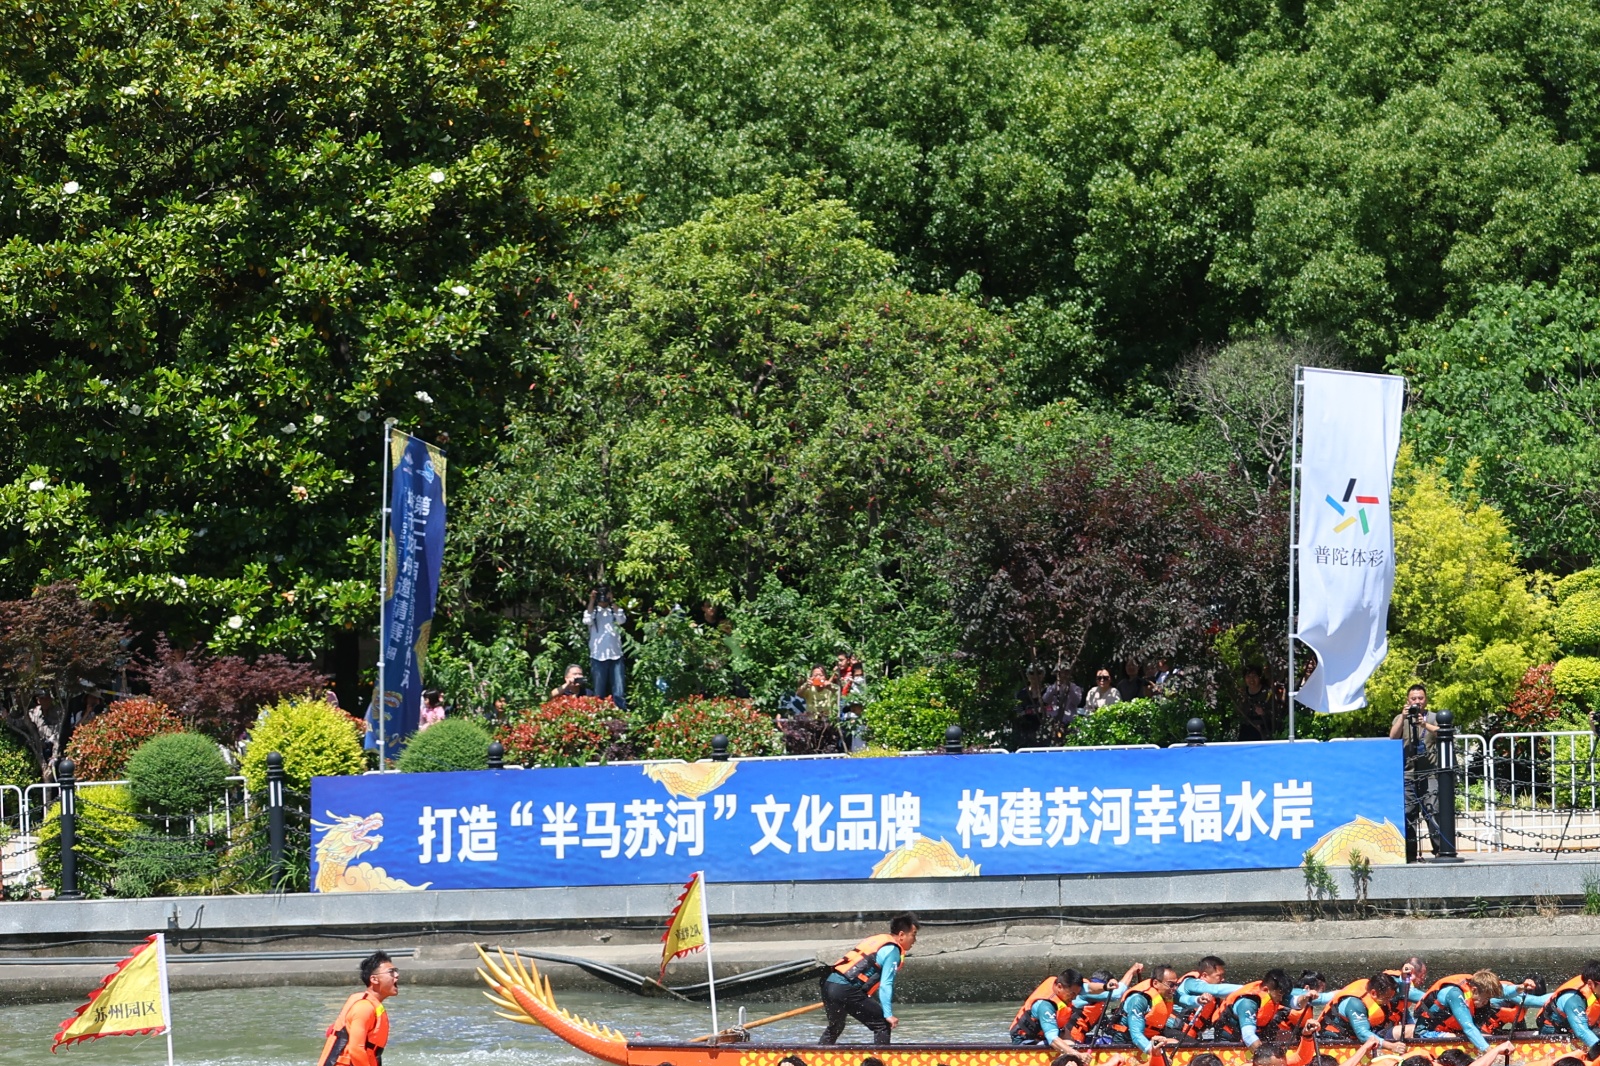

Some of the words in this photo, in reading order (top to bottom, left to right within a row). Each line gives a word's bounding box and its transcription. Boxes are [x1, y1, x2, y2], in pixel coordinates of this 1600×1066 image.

[1314, 545, 1384, 567] 普陀体彩
[956, 780, 1315, 850] 构建苏河幸福水岸
[95, 1000, 157, 1024] 苏州园区
